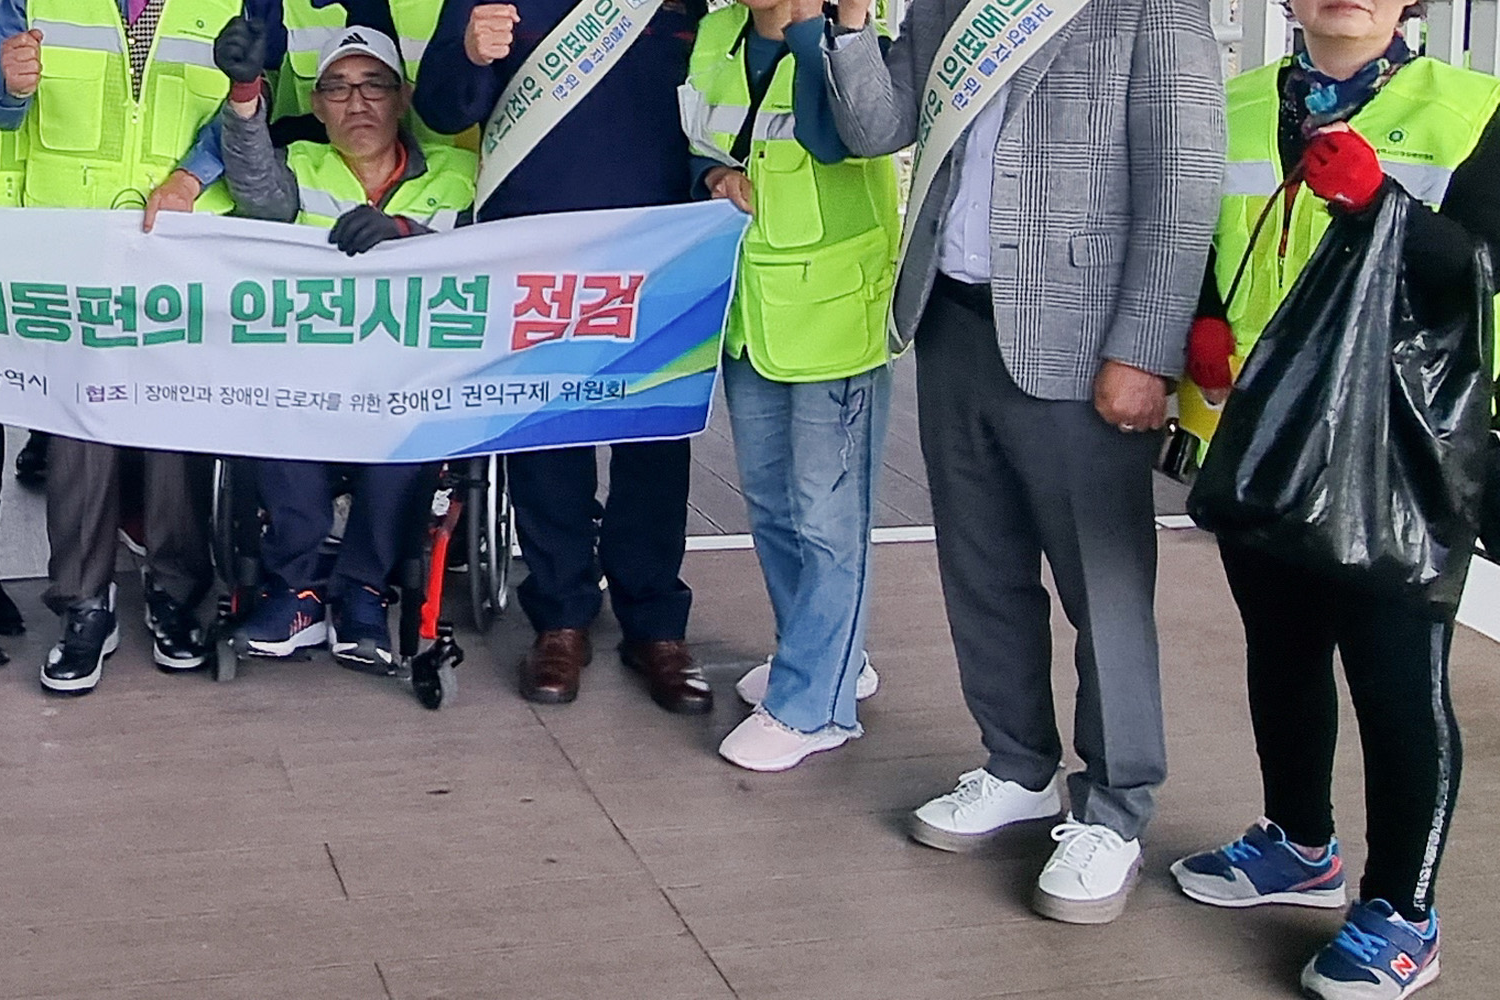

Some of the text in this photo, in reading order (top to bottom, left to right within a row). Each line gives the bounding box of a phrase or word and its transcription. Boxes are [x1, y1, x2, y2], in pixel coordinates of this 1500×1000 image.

[951, 2, 1053, 111] 보행약자를 위한
[552, 74, 580, 101] 위한
[230, 275, 491, 349] 안전시설
[511, 274, 644, 351] 점검
[85, 384, 129, 403] 협조
[145, 384, 213, 403] 장애인과
[219, 386, 270, 407] 장애인
[274, 387, 342, 411] 근로자를
[349, 391, 382, 413] 위한
[387, 386, 451, 415] 장애인
[461, 381, 550, 408] 권익구제
[559, 379, 628, 402] 위원회
